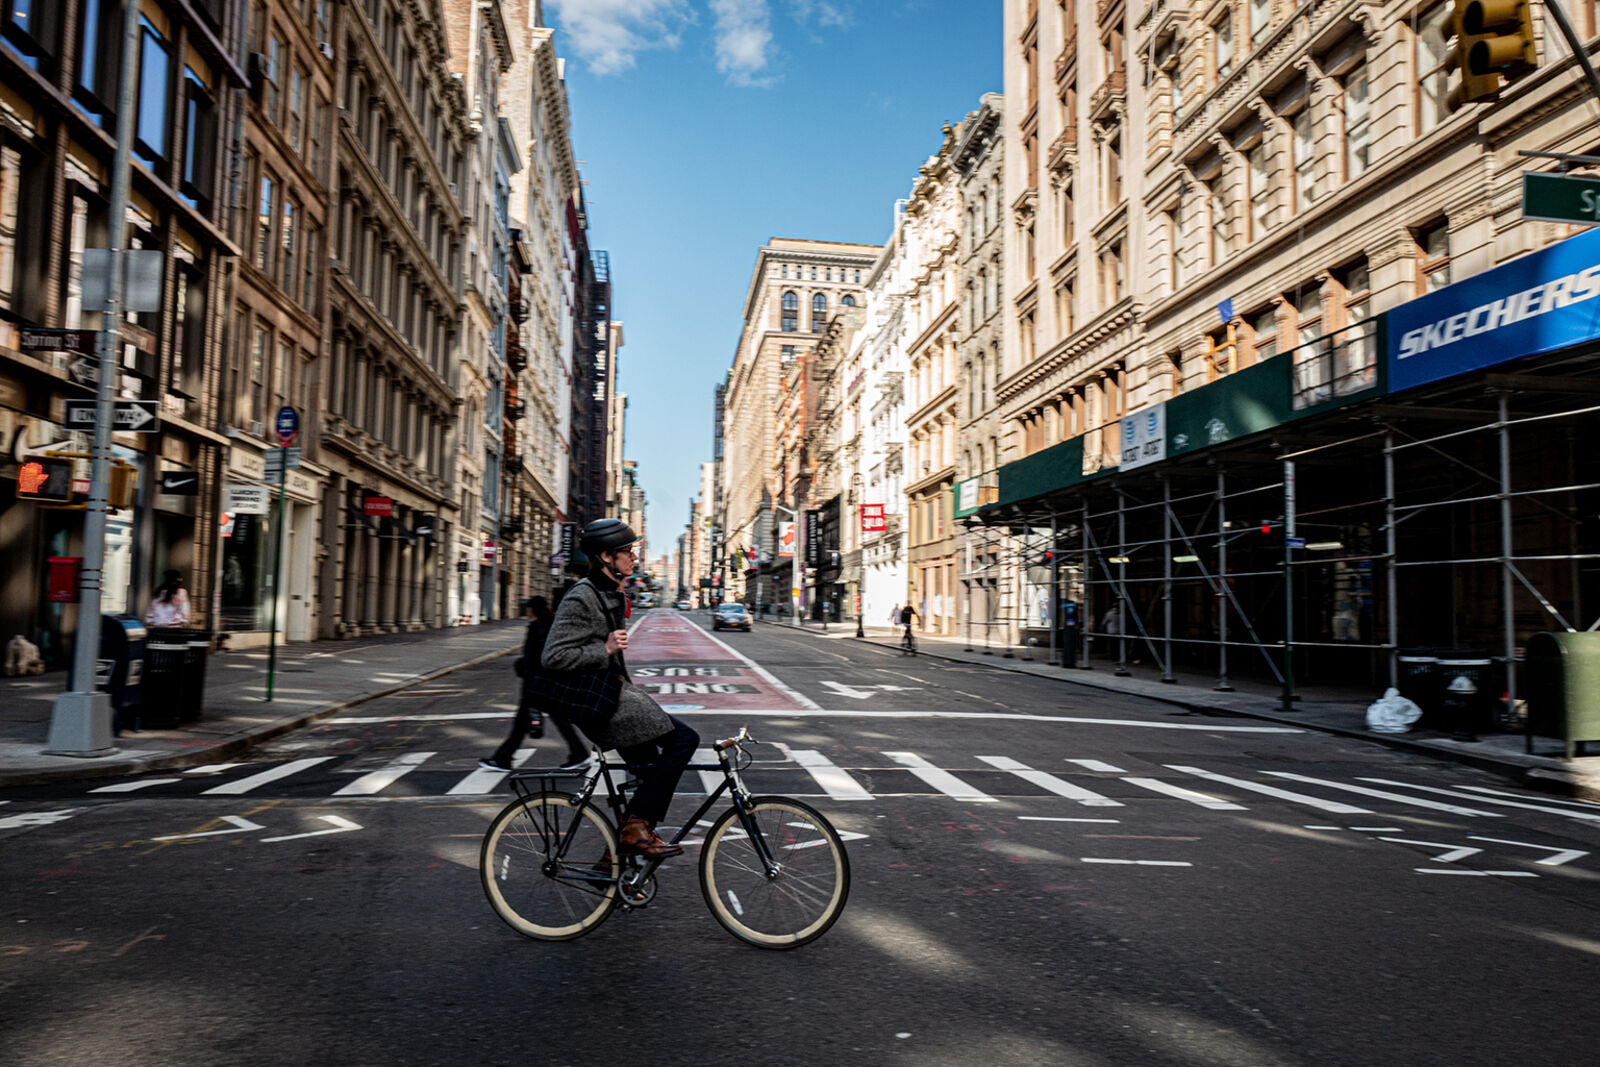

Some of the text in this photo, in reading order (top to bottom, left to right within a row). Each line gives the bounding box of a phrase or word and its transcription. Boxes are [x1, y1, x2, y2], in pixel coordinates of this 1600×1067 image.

[21, 330, 80, 351] Spring St
[1398, 264, 1600, 360] SKECHERS
